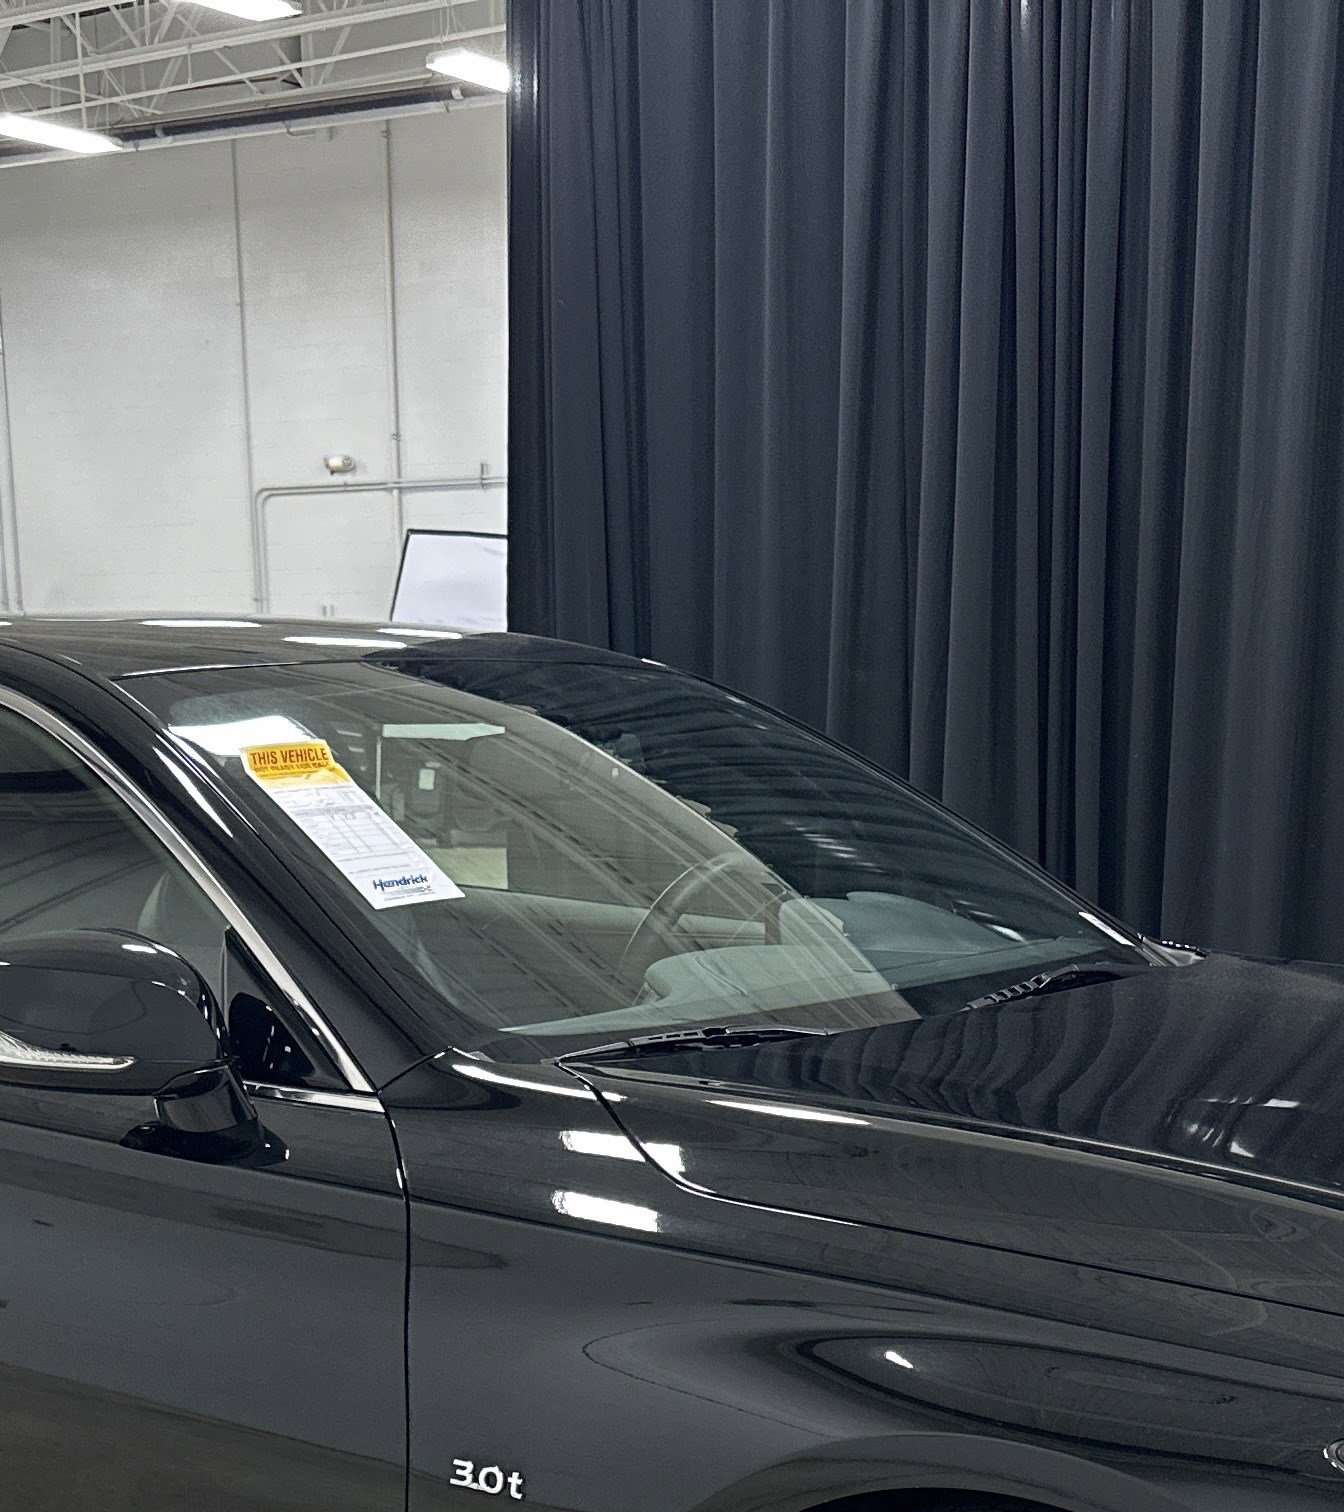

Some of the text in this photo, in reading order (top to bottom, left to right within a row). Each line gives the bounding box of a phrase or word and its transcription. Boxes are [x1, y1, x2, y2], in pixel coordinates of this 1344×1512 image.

[249, 748, 330, 766] THIS VEHICLE
[372, 873, 429, 891] Hendrick
